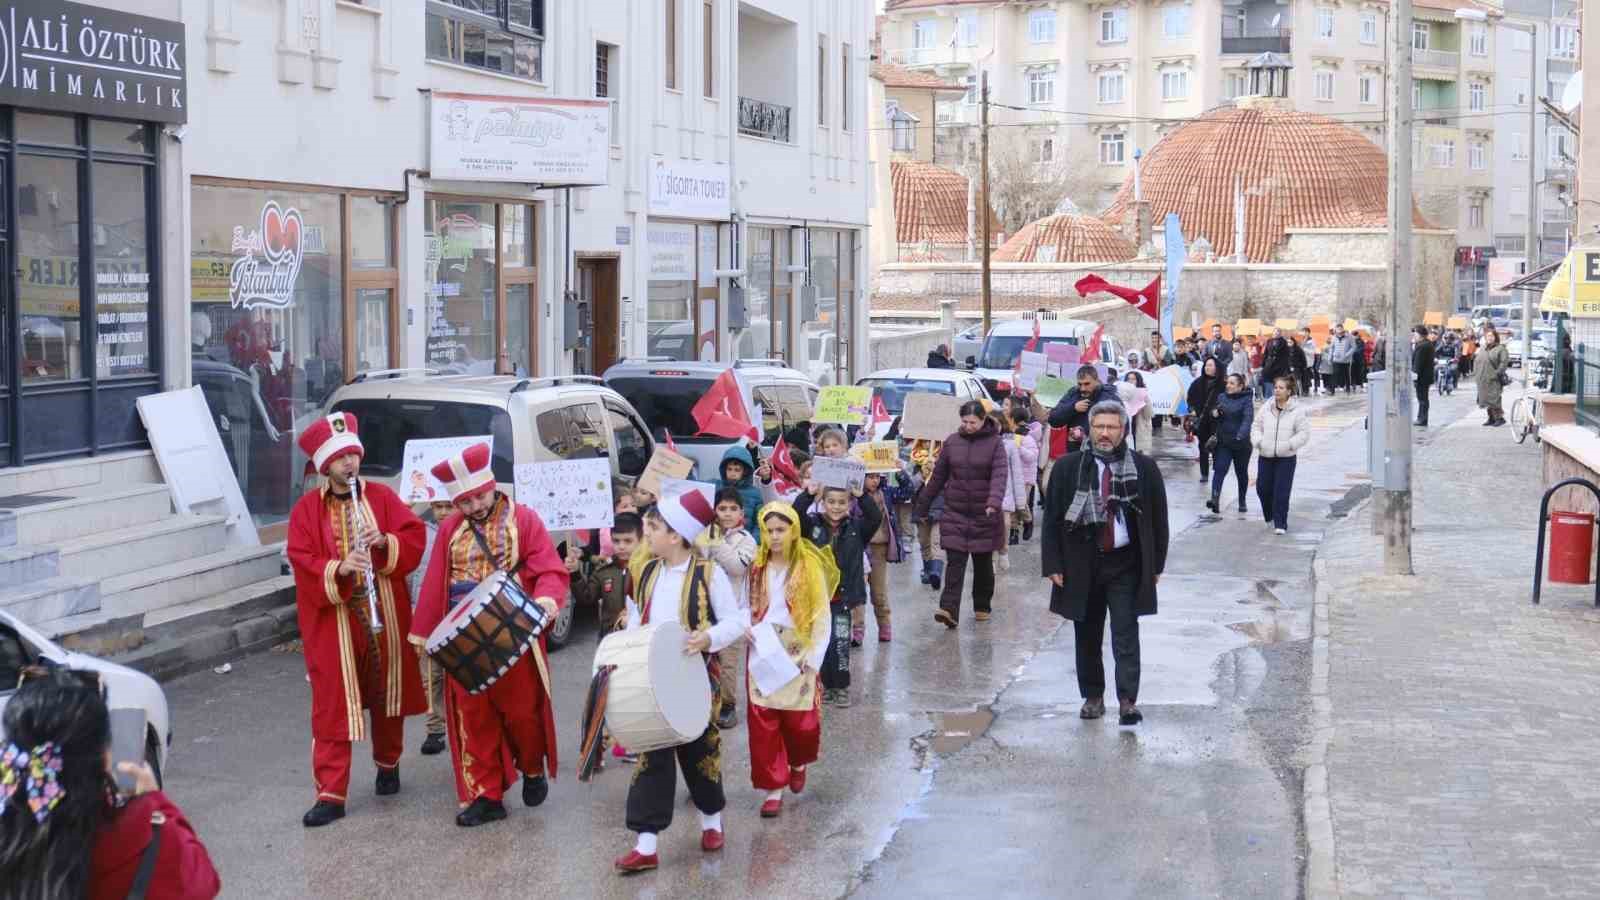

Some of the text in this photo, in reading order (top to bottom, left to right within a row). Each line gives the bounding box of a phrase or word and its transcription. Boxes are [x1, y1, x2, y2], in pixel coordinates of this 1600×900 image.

[22, 14, 182, 71] ALİ ÖZTÜRK
[22, 66, 183, 109] MİMARLIK
